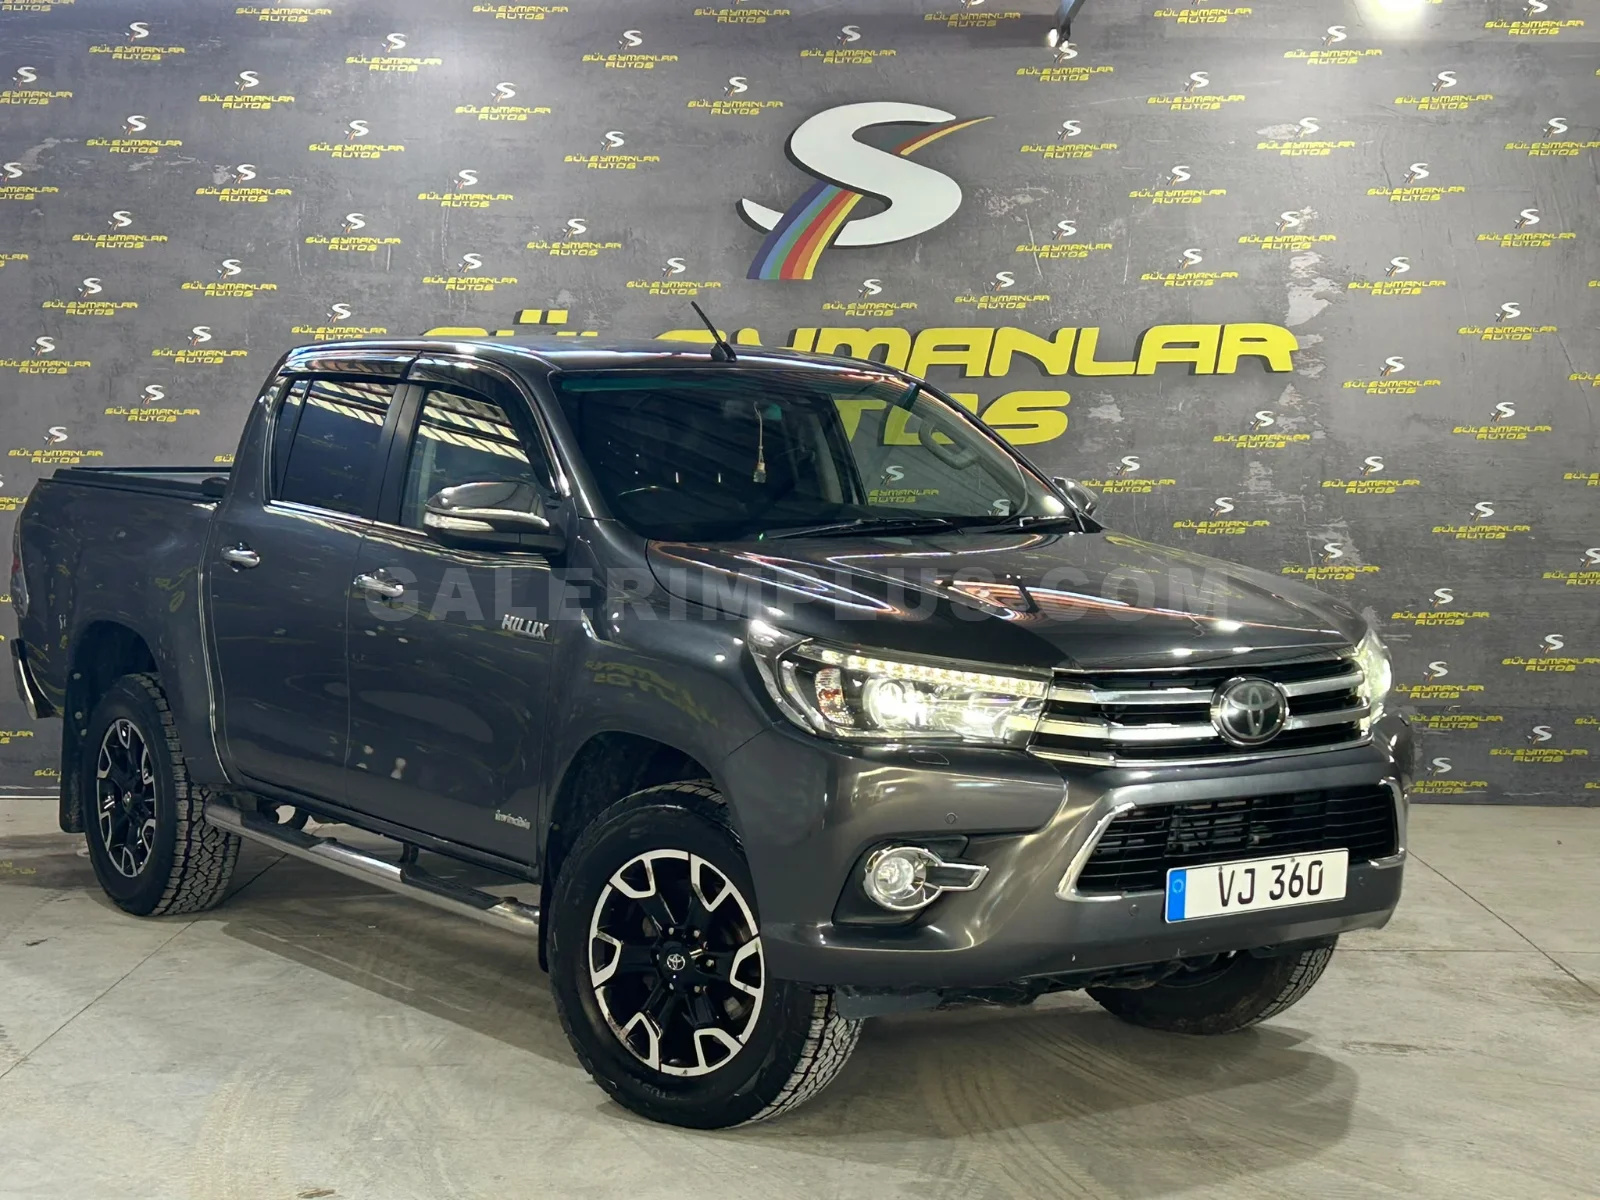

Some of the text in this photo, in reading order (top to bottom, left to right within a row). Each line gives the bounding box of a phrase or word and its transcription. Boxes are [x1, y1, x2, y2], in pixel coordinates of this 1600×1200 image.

[258, 16, 309, 24] AUTOS
[111, 54, 163, 62] AUTOS
[604, 62, 657, 71] AUTOS
[222, 103, 273, 111] AUTOS
[1169, 104, 1222, 112] AUTOS
[711, 109, 761, 117] AUTOS
[477, 114, 528, 122] AUTOS
[109, 147, 160, 155] AUTOS
[586, 163, 638, 171] AUTOS
[218, 196, 269, 204] AUTOS
[327, 245, 378, 253] AUTOS
[549, 250, 599, 258] AUTOS
[203, 291, 255, 299] AUTOS
[65, 309, 117, 317] AUTOS
[844, 310, 896, 318] AUTOS
[1566, 578, 1600, 586] AUTO
[501, 613, 550, 640] HILUX
[1395, 683, 1485, 692] ÜLEYMANLAR
[1218, 860, 1323, 907] VJ 360
